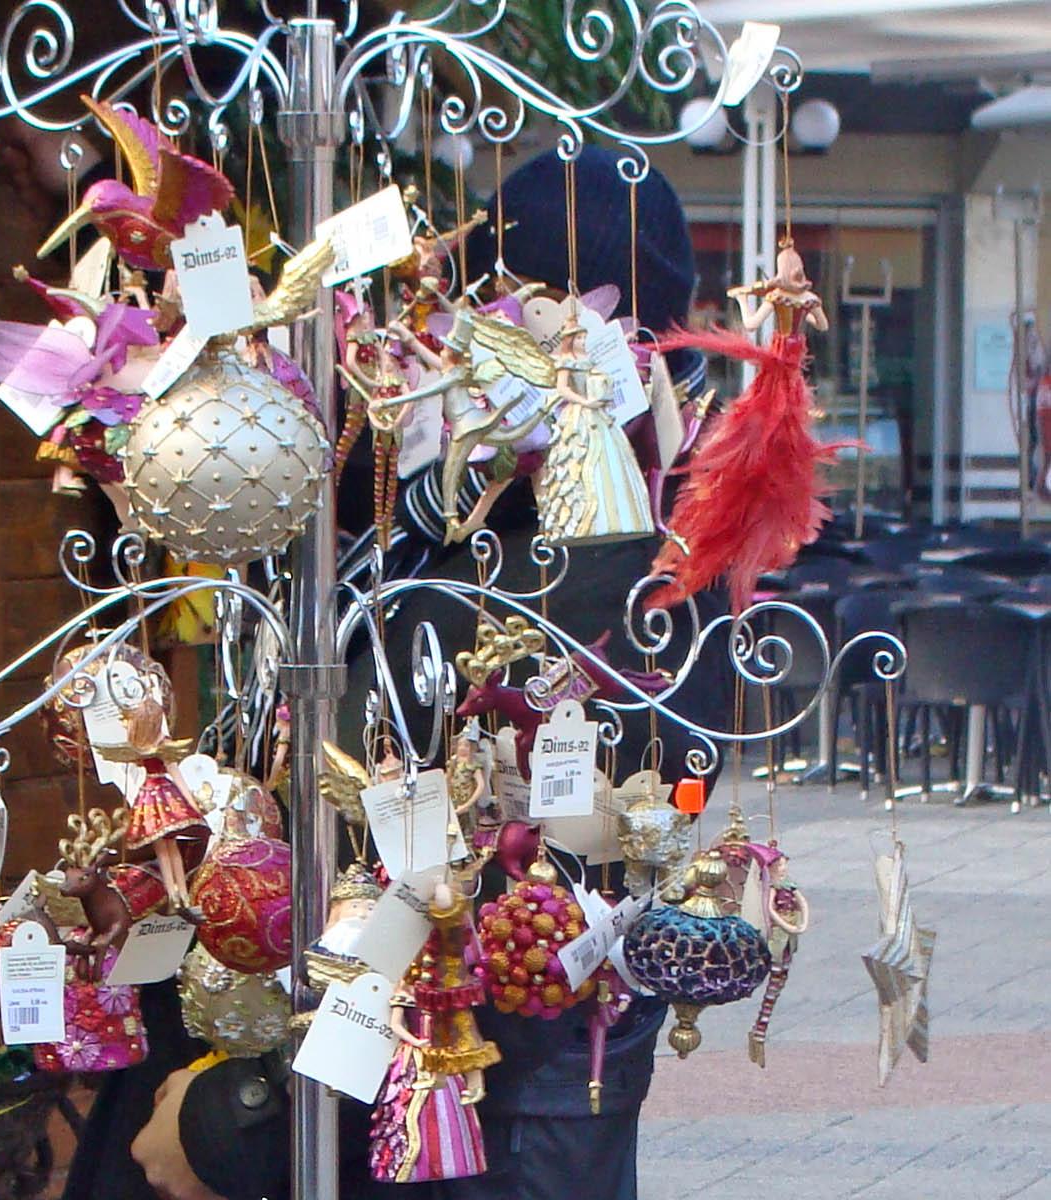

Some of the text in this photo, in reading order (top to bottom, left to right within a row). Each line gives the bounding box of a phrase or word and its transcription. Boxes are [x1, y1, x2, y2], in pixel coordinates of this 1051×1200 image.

[180, 245, 238, 270] Dims-92
[541, 735, 589, 754] Dims-92
[330, 996, 395, 1040] Dims-92
